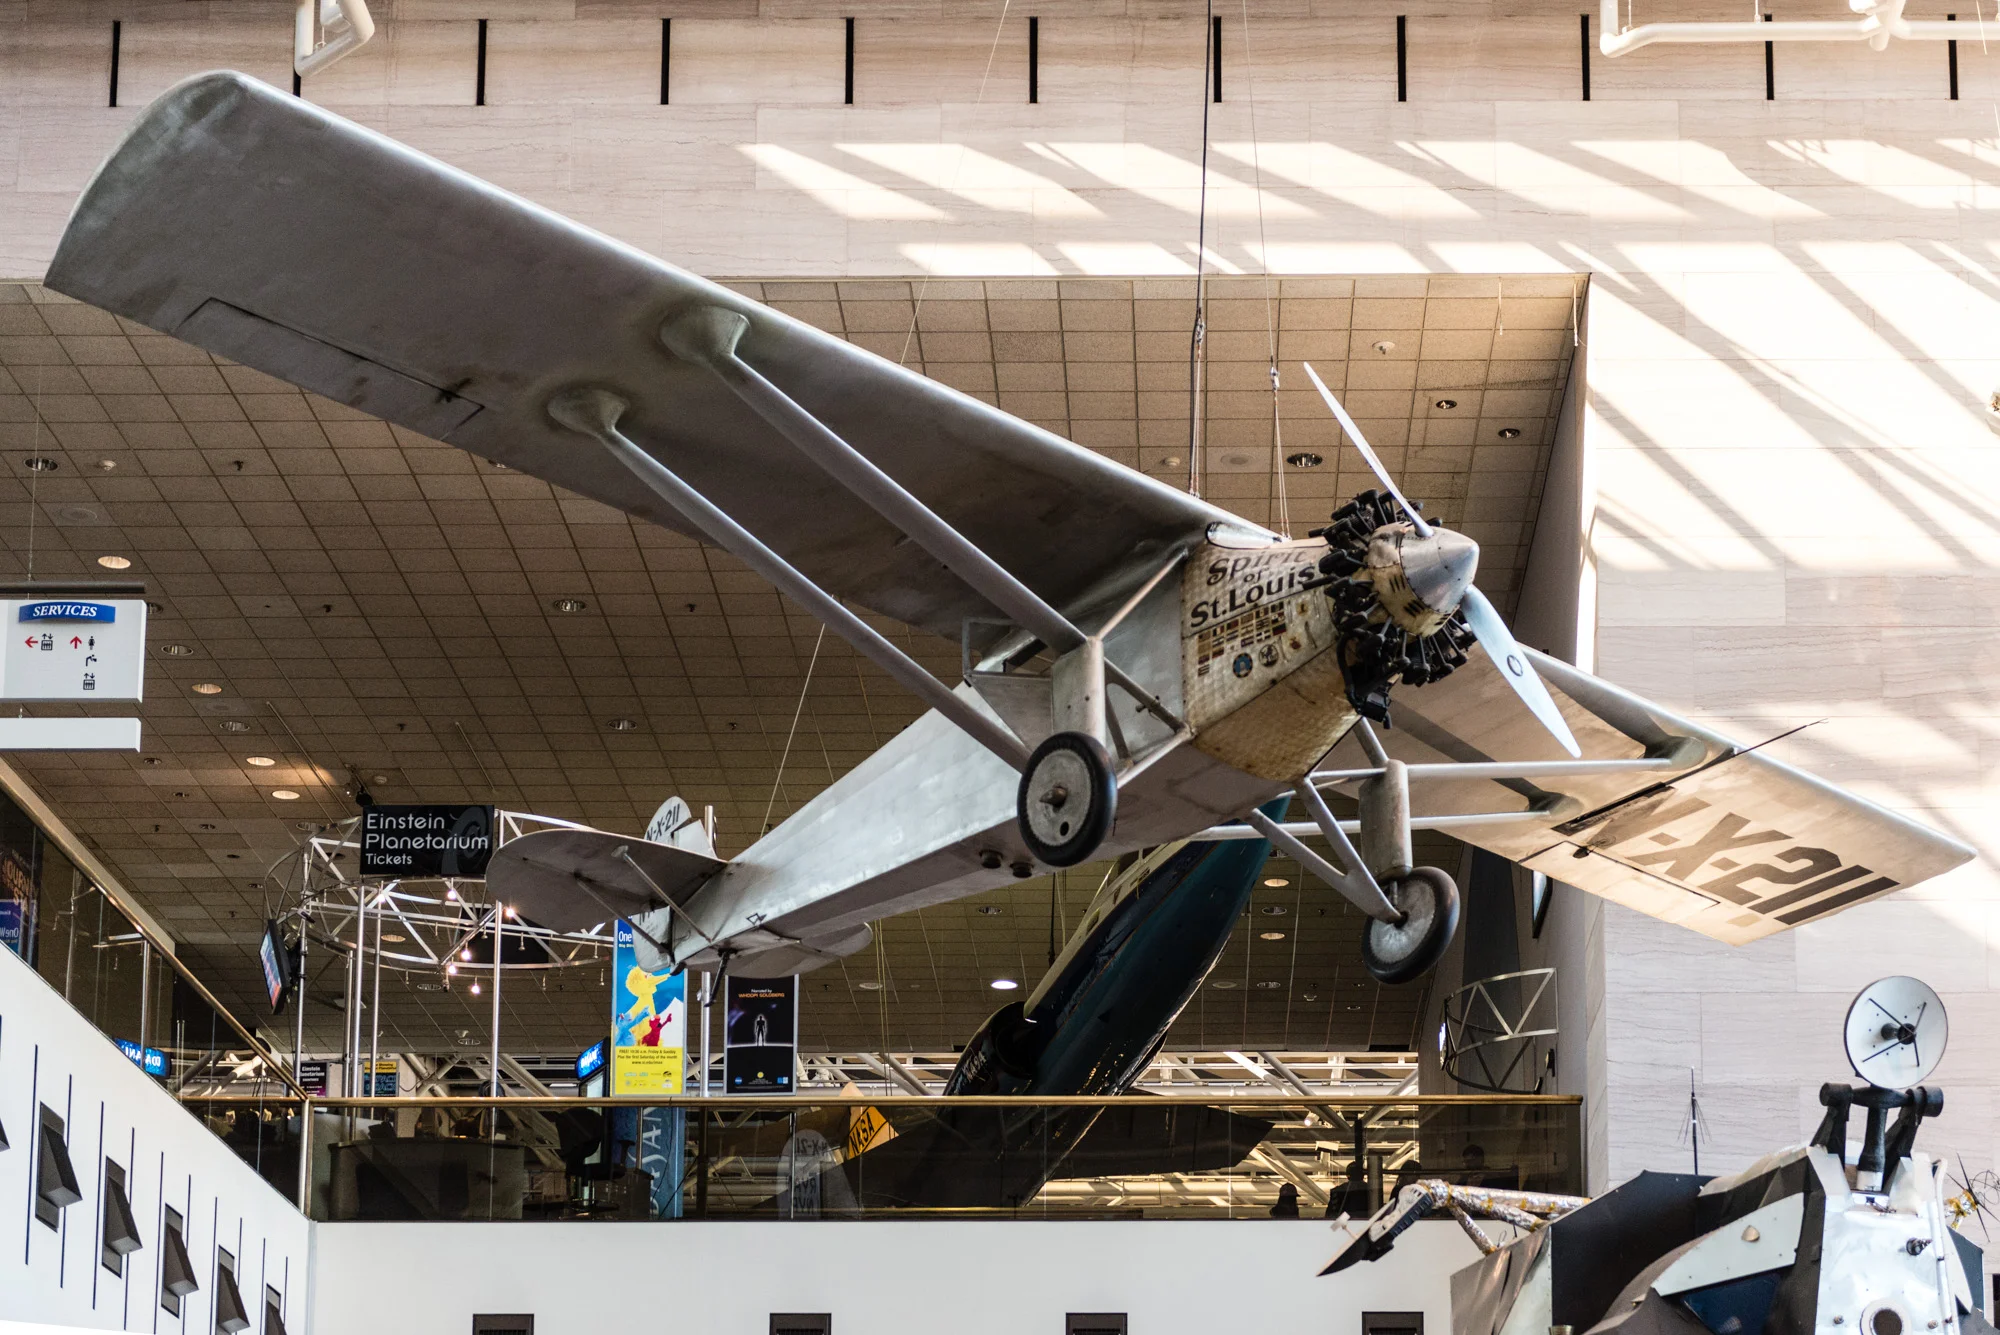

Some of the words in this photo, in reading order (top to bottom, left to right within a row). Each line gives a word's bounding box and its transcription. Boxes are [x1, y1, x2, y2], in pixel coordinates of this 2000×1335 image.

[1206, 550, 1308, 586] Spirit
[1243, 566, 1269, 583] of
[32, 604, 98, 618] SERVICES
[366, 813, 446, 830] Einstein
[365, 833, 489, 850] Planetarium
[365, 853, 413, 866] Tickets
[618, 931, 632, 942] One
[849, 1111, 875, 1156] NASA
